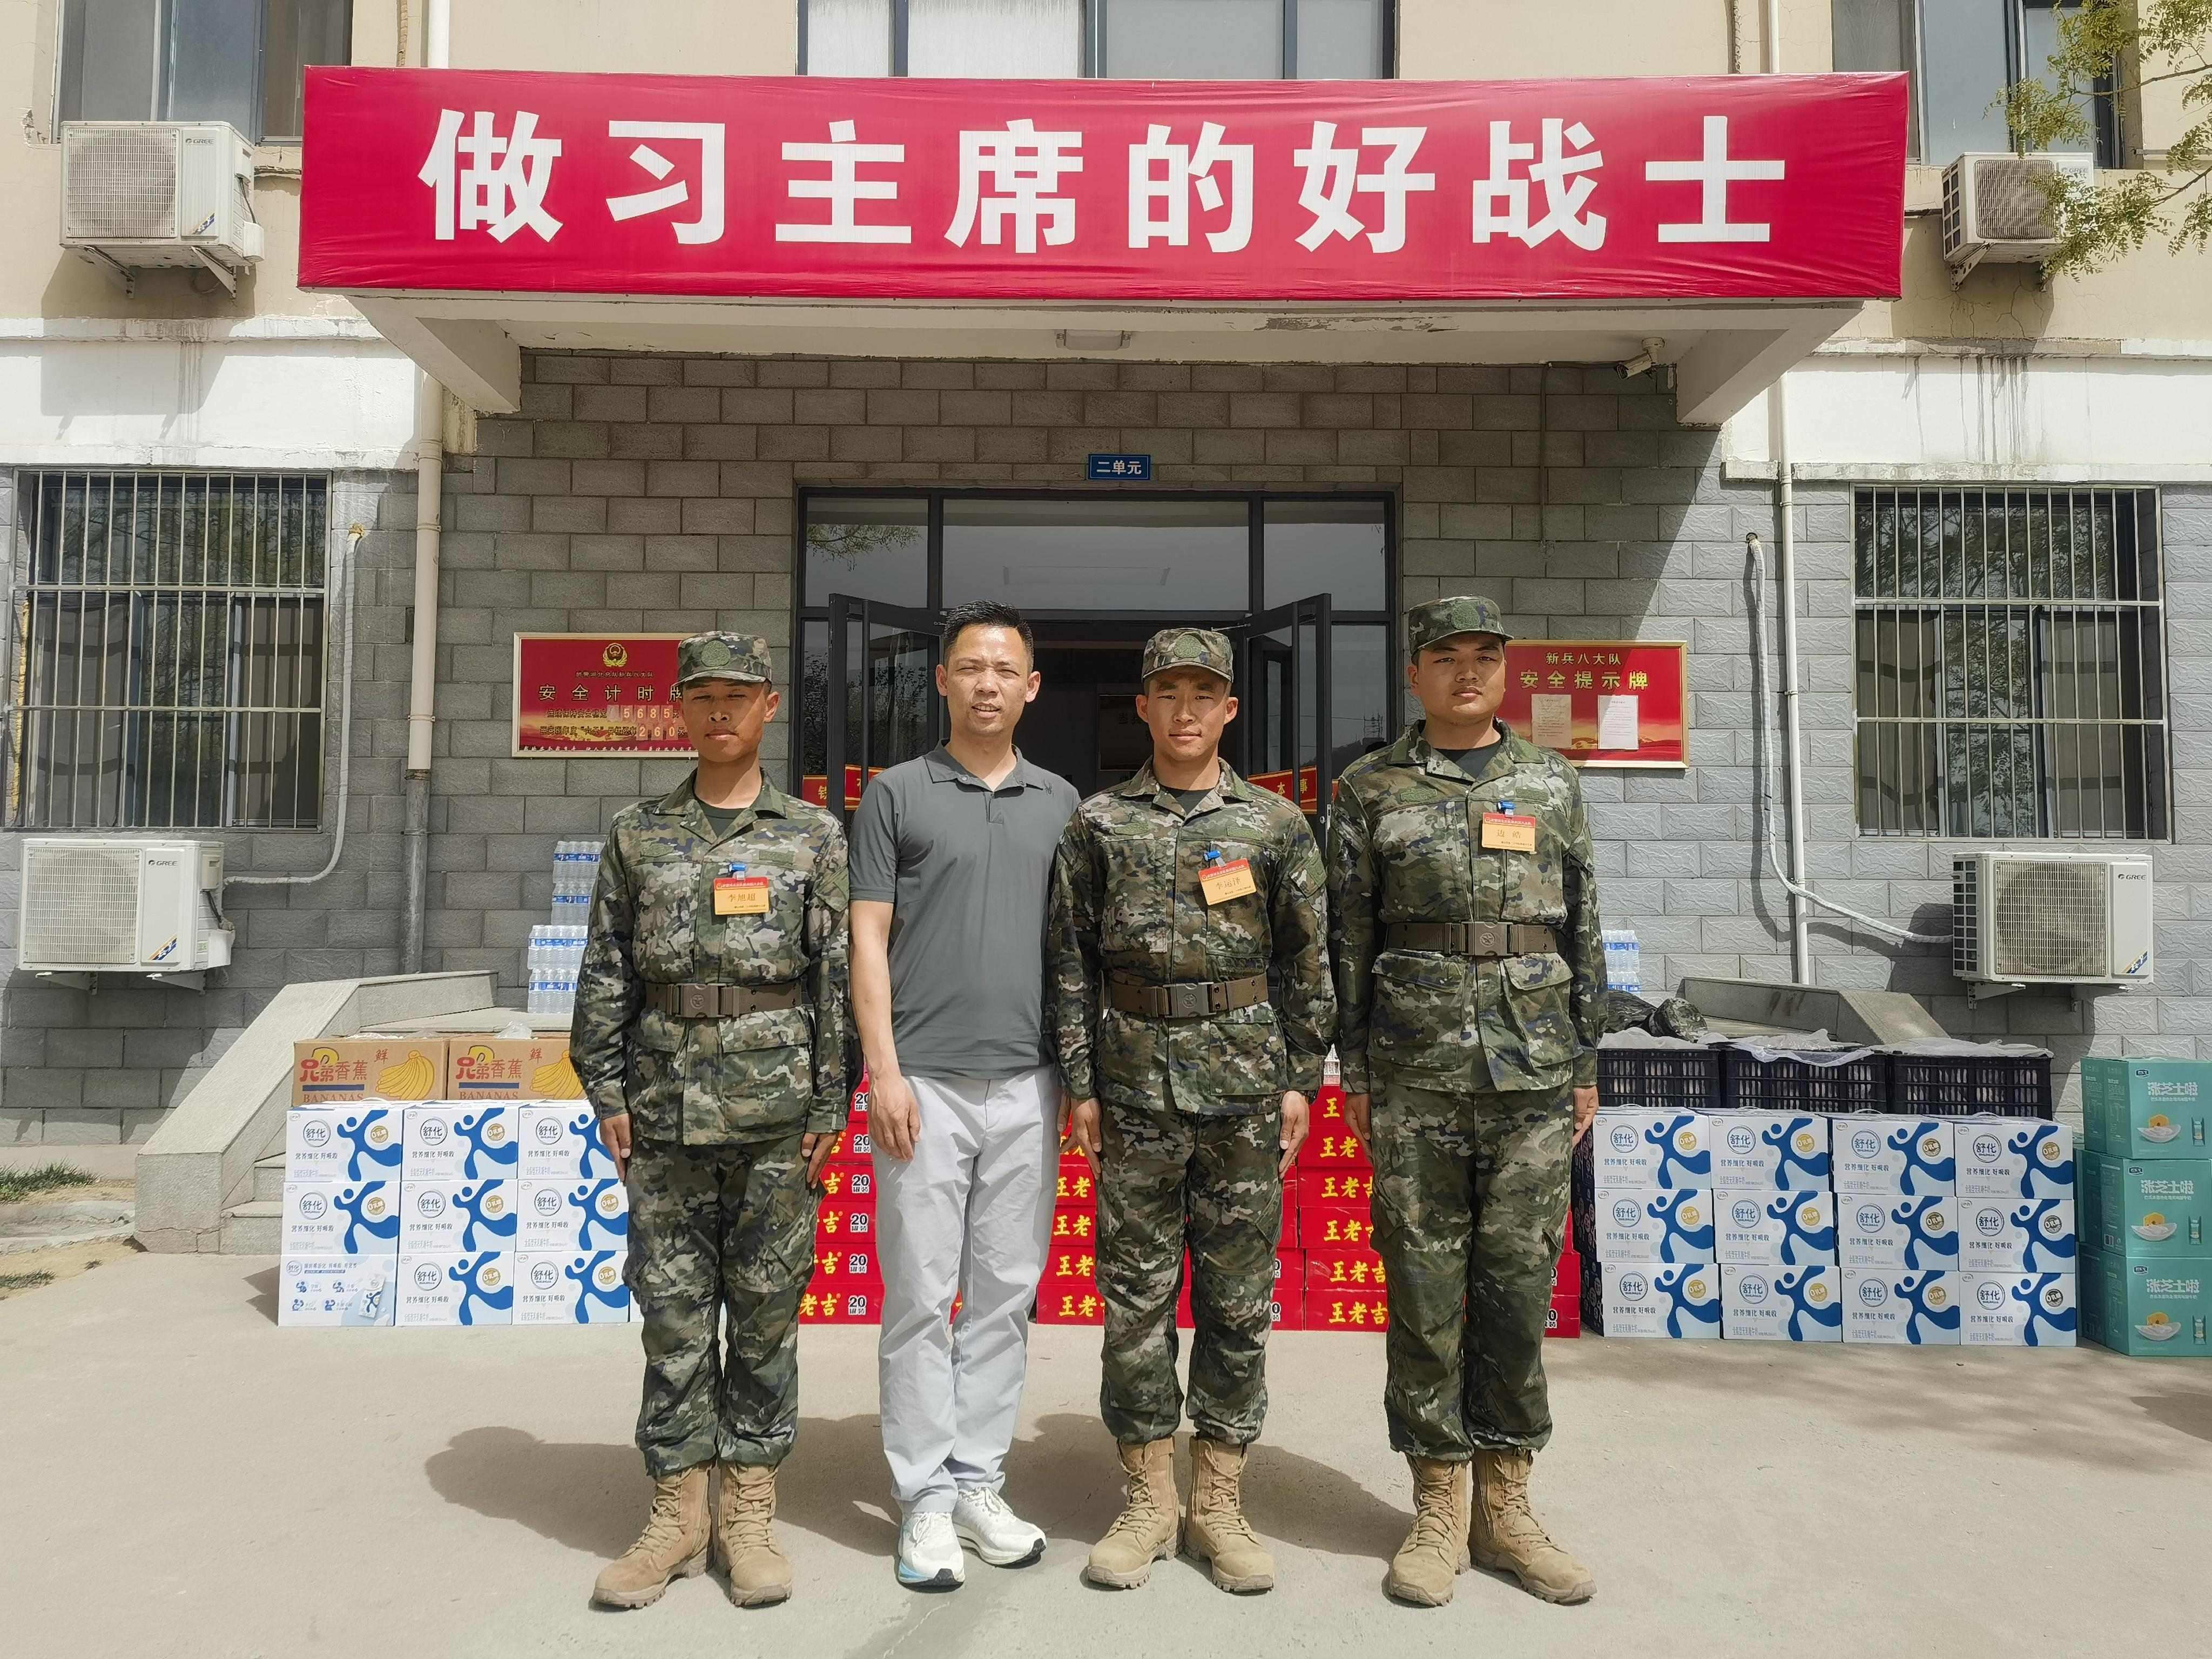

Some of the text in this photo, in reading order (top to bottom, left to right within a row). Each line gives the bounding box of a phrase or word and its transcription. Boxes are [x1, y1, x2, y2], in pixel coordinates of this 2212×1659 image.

[419, 110, 1786, 254] 做习主席的好战士
[1096, 460, 1142, 475] 二单元
[1546, 652, 1621, 666] 新兵八大队
[1520, 669, 1648, 691] 安全提示牌
[374, 1048, 388, 1065] 鲜
[529, 1048, 542, 1063] 鲜
[303, 1093, 364, 1102] BANANAS
[460, 1091, 518, 1100] BANANAS
[306, 1128, 325, 1138] 舒化
[423, 1125, 442, 1136] 舒化
[538, 1125, 557, 1136] 舒化
[854, 1136, 869, 1145] 20
[1613, 1134, 1633, 1144] 舒化
[1730, 1135, 1750, 1145] 舒化
[1854, 1139, 1875, 1149] 舒化
[1320, 1136, 1358, 1158] 王老
[1975, 1143, 1996, 1154] 舒化
[853, 1176, 869, 1186] 20
[1056, 1176, 1091, 1198] 王老
[302, 1199, 322, 1210] 舒化
[421, 1198, 440, 1209] 舒化
[537, 1196, 557, 1207] 舒化
[1615, 1208, 1636, 1218] 舒化
[1735, 1209, 1755, 1218] 舒化
[1859, 1213, 1879, 1223] 舒化
[852, 1215, 867, 1225] 20
[1979, 1217, 1999, 1227] 舒化
[1053, 1215, 1091, 1237] 王老
[850, 1256, 866, 1265] 20
[1056, 1255, 1094, 1277] 王老
[417, 1270, 437, 1282] 舒化
[534, 1269, 553, 1280] 舒化
[1330, 1260, 1386, 1283] 王老吉
[1622, 1282, 1642, 1292] 舒化
[1742, 1284, 1763, 1294] 舒化
[1862, 1287, 1882, 1298] 舒化
[1980, 1290, 2000, 1300] 舒化
[849, 1297, 865, 1307] 20
[1058, 1295, 1105, 1317] 王老
[1328, 1301, 1388, 1325] 王老吉
